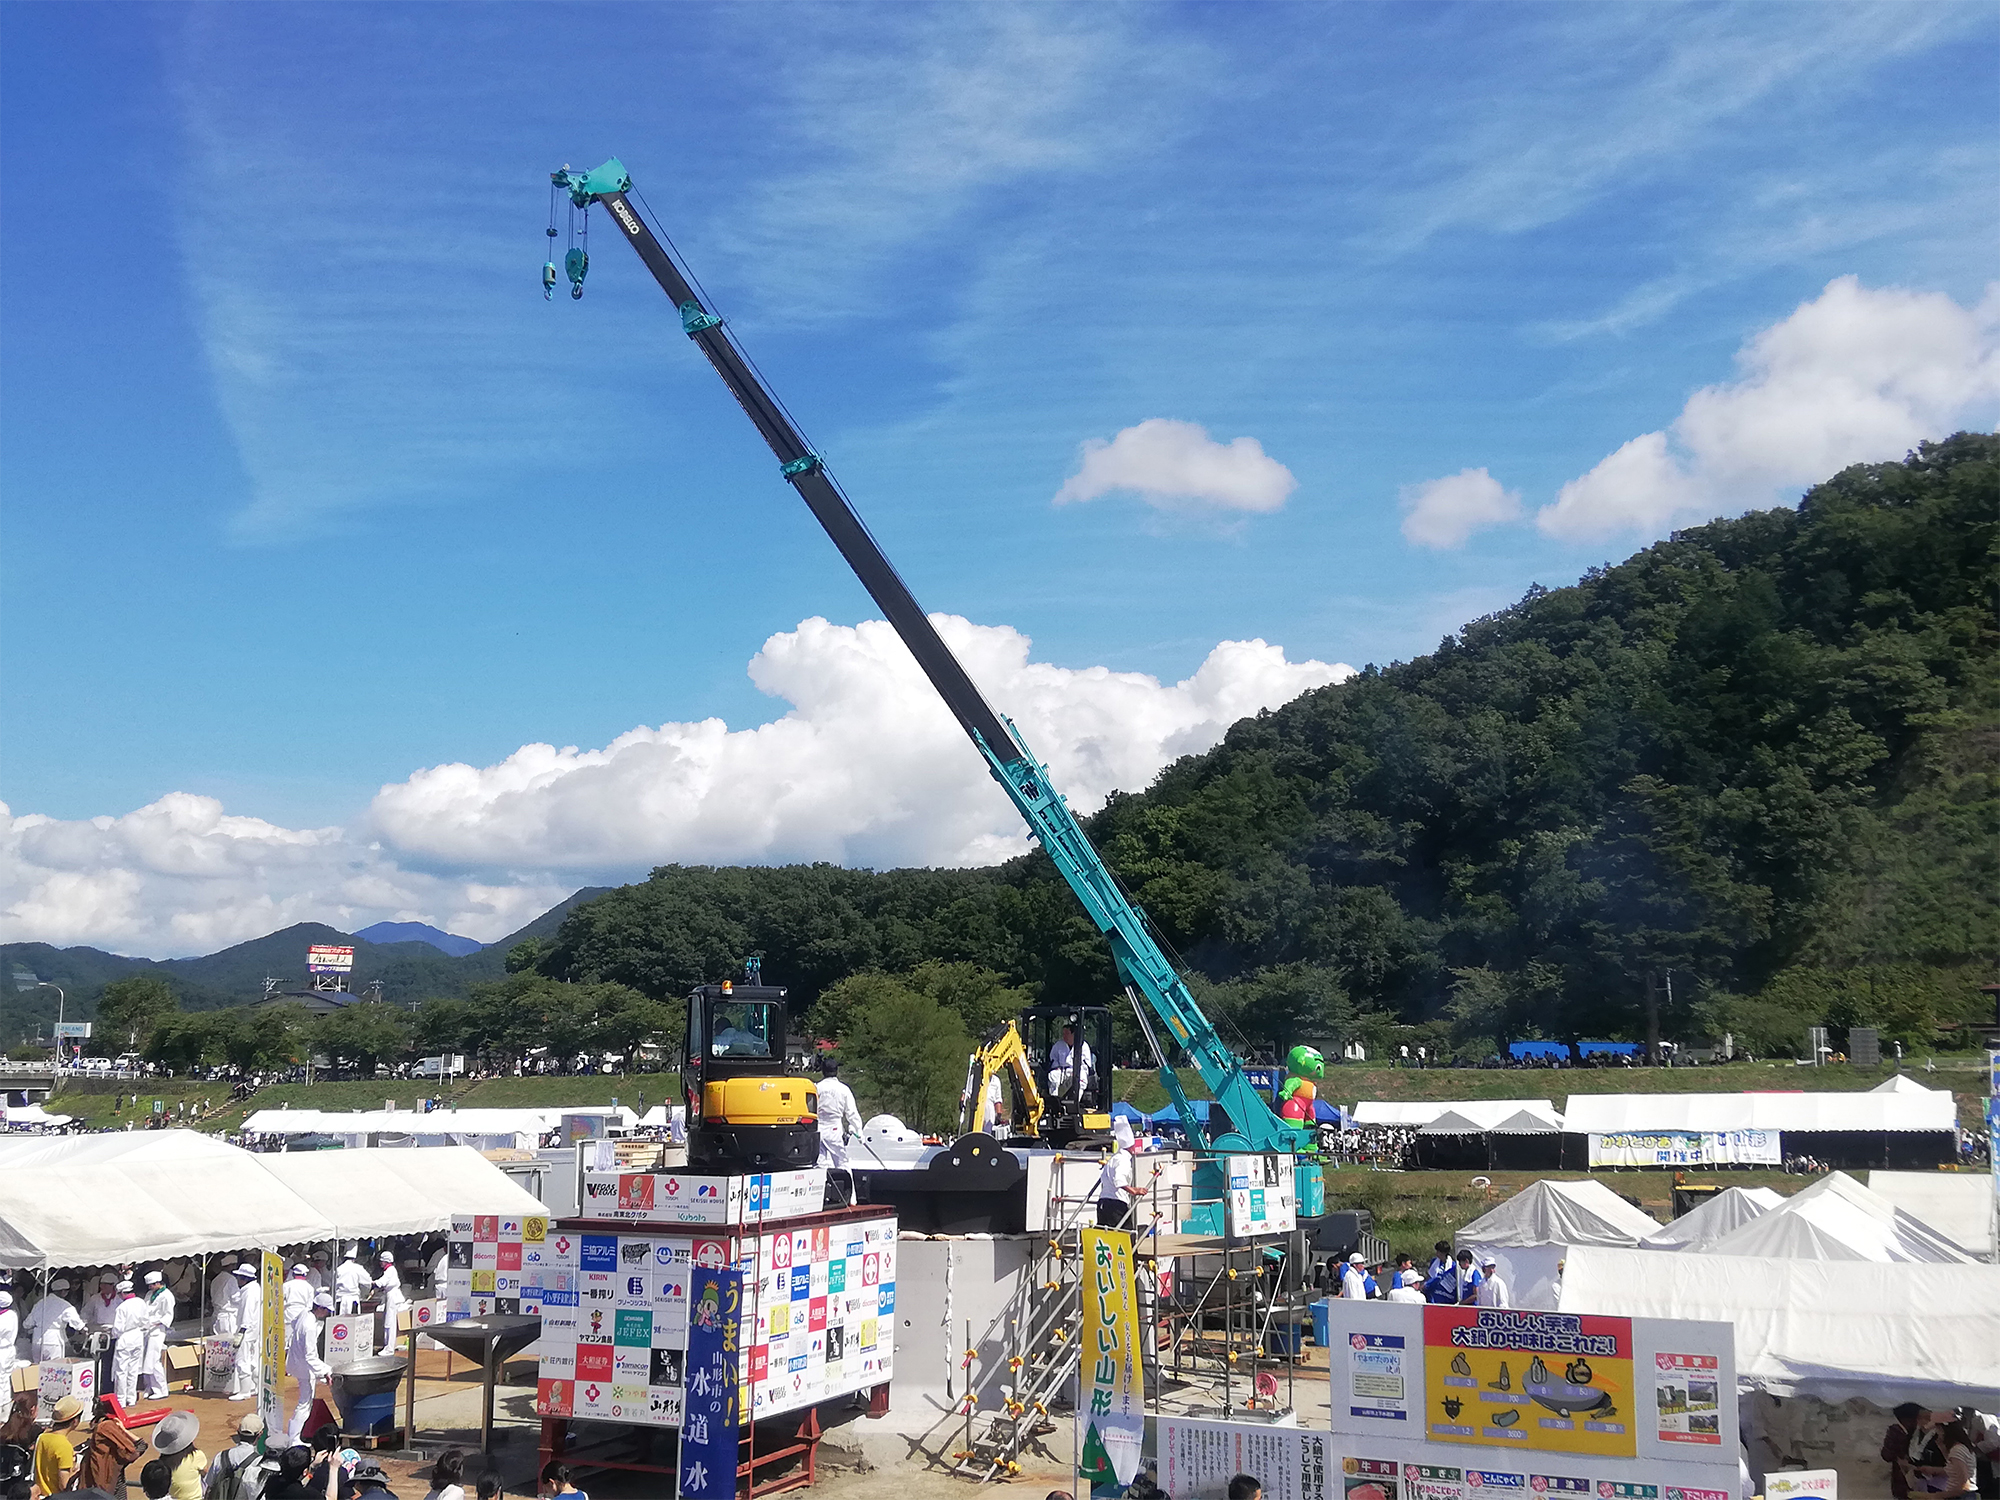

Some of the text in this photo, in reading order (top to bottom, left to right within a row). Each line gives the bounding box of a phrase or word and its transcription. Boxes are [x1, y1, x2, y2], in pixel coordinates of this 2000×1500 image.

[612, 199, 640, 235] KOBELCO
[582, 1244, 617, 1256] 三協アルミ
[543, 1292, 579, 1305] 小野建設
[582, 1289, 614, 1300] 一番搾り
[1478, 1309, 1582, 1334] おいしい芋煮
[616, 1327, 649, 1338] JEFEX
[1091, 1238, 1118, 1418] おいしい山形
[579, 1334, 613, 1344] ヤマコン食品
[1373, 1337, 1383, 1346] 水
[1451, 1326, 1617, 1356] 大鍋の中味はこれだ!
[582, 1355, 608, 1366] 大和証券
[709, 1351, 723, 1413] 山形市の
[684, 1366, 711, 1492] 水道水
[1361, 1461, 1391, 1474] 牛肉
[1421, 1467, 1446, 1478] ねぎ
[1483, 1474, 1516, 1486] こんにゃく
